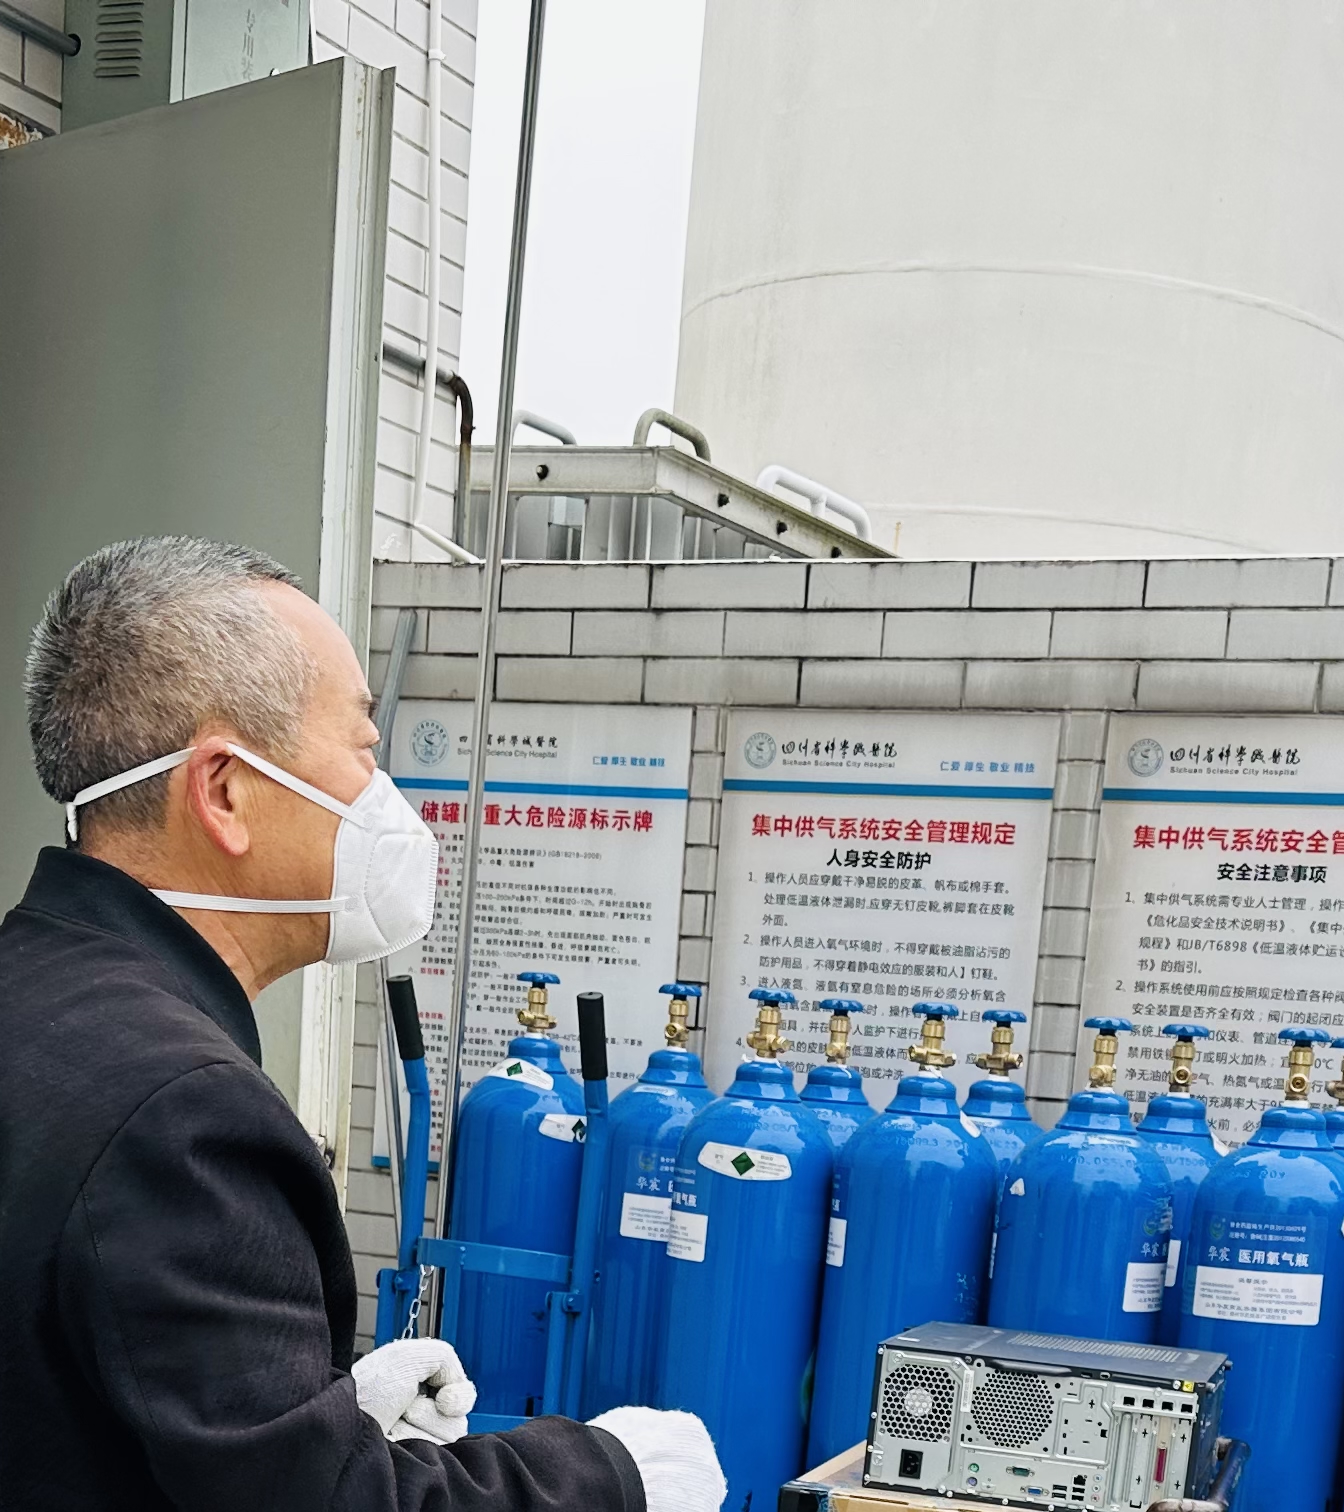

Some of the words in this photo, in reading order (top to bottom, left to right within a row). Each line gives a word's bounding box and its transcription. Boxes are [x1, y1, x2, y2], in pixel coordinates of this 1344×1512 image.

[421, 800, 654, 832] 储罐重大危险源标示牌
[752, 814, 1016, 845] 集中供气系统安全管理规定
[826, 848, 932, 870] 人身安全防护
[1217, 863, 1329, 883] 安全注意事项
[1238, 1248, 1309, 1267] 医用氧气瓶
